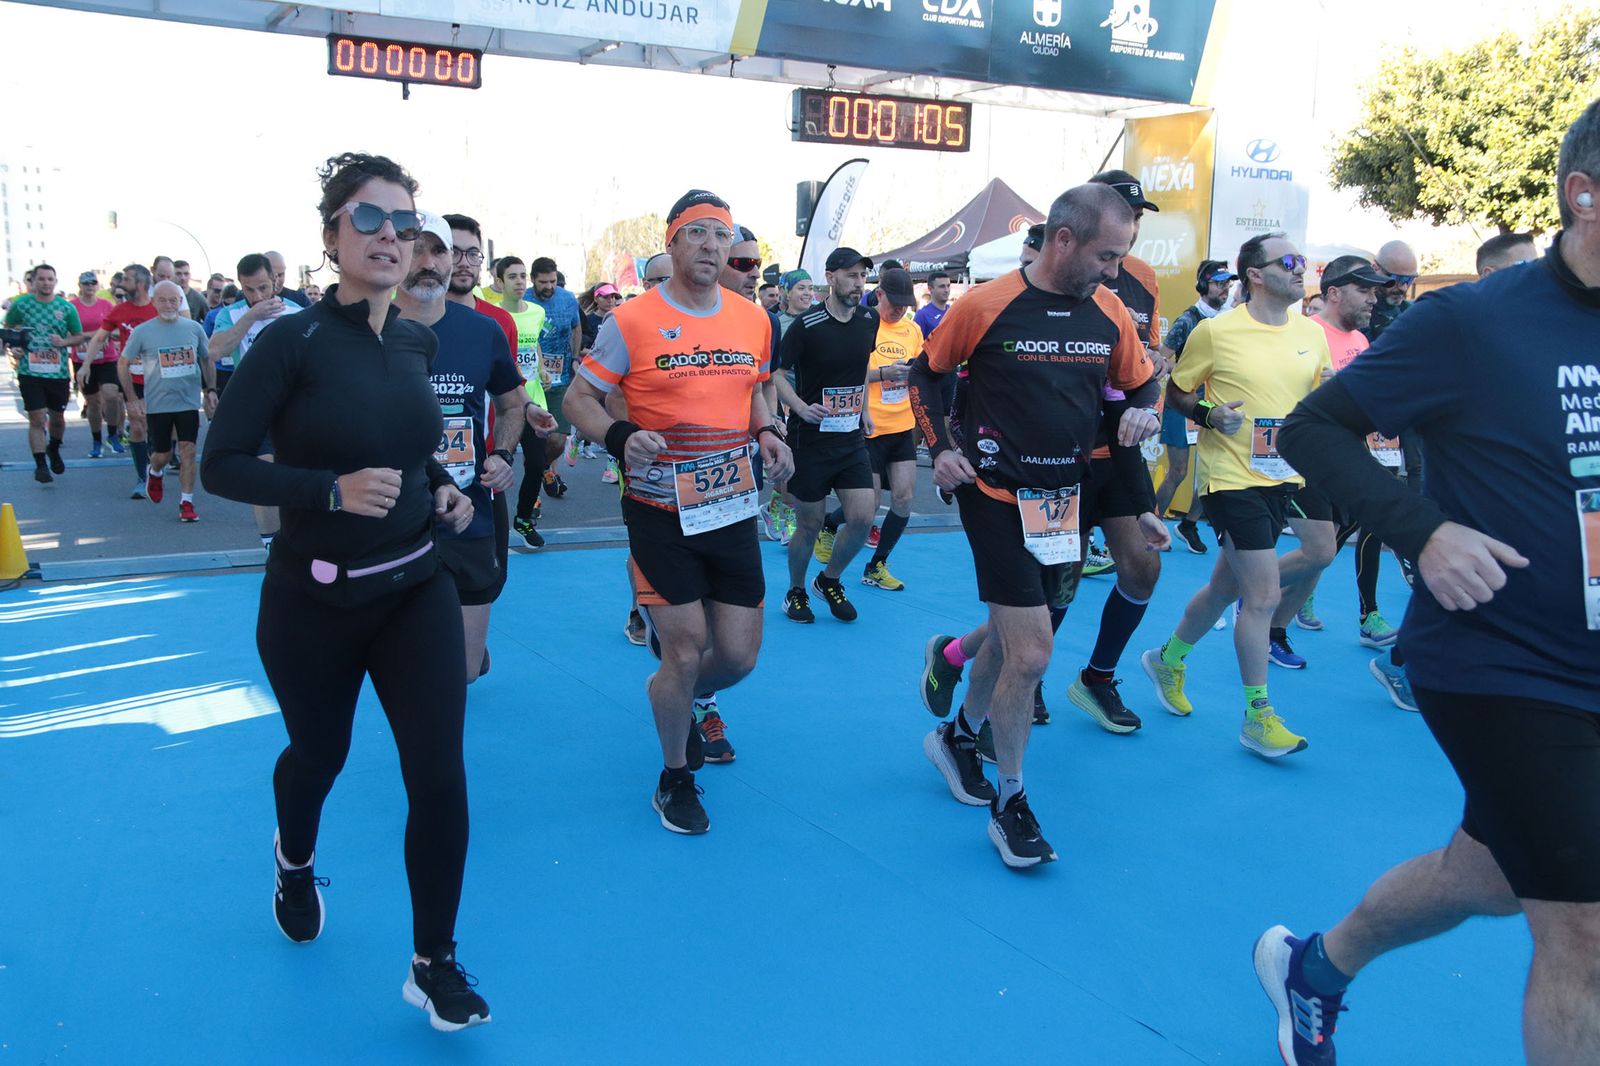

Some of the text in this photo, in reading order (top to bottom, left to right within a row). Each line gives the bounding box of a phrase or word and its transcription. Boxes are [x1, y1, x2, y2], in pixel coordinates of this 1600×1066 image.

[922, 12, 937, 22] CLUB
[937, 14, 969, 27] DEPORTIVO
[1019, 31, 1071, 49] ALMERÍA
[1032, 46, 1059, 57] CIUDAD
[1110, 44, 1144, 58] DEPORTES
[1144, 49, 1155, 59] DE
[1139, 160, 1195, 193] NEXA
[1231, 166, 1293, 182] HYUNDAI
[1235, 217, 1281, 228] ESTRELLA
[1003, 341, 1112, 356] GADOR CORRE
[164, 353, 191, 361] 1731
[657, 353, 755, 369] GADOR CORRE
[1050, 355, 1074, 363] BUEN
[1075, 356, 1105, 364] PASTOR
[669, 370, 688, 379] CON
[699, 368, 720, 376] BUEN
[722, 368, 752, 377] PASTOR
[830, 394, 861, 409] 1516
[1020, 455, 1076, 465] LAALMAZARA
[694, 462, 742, 493] 522
[1039, 498, 1071, 521] 137
